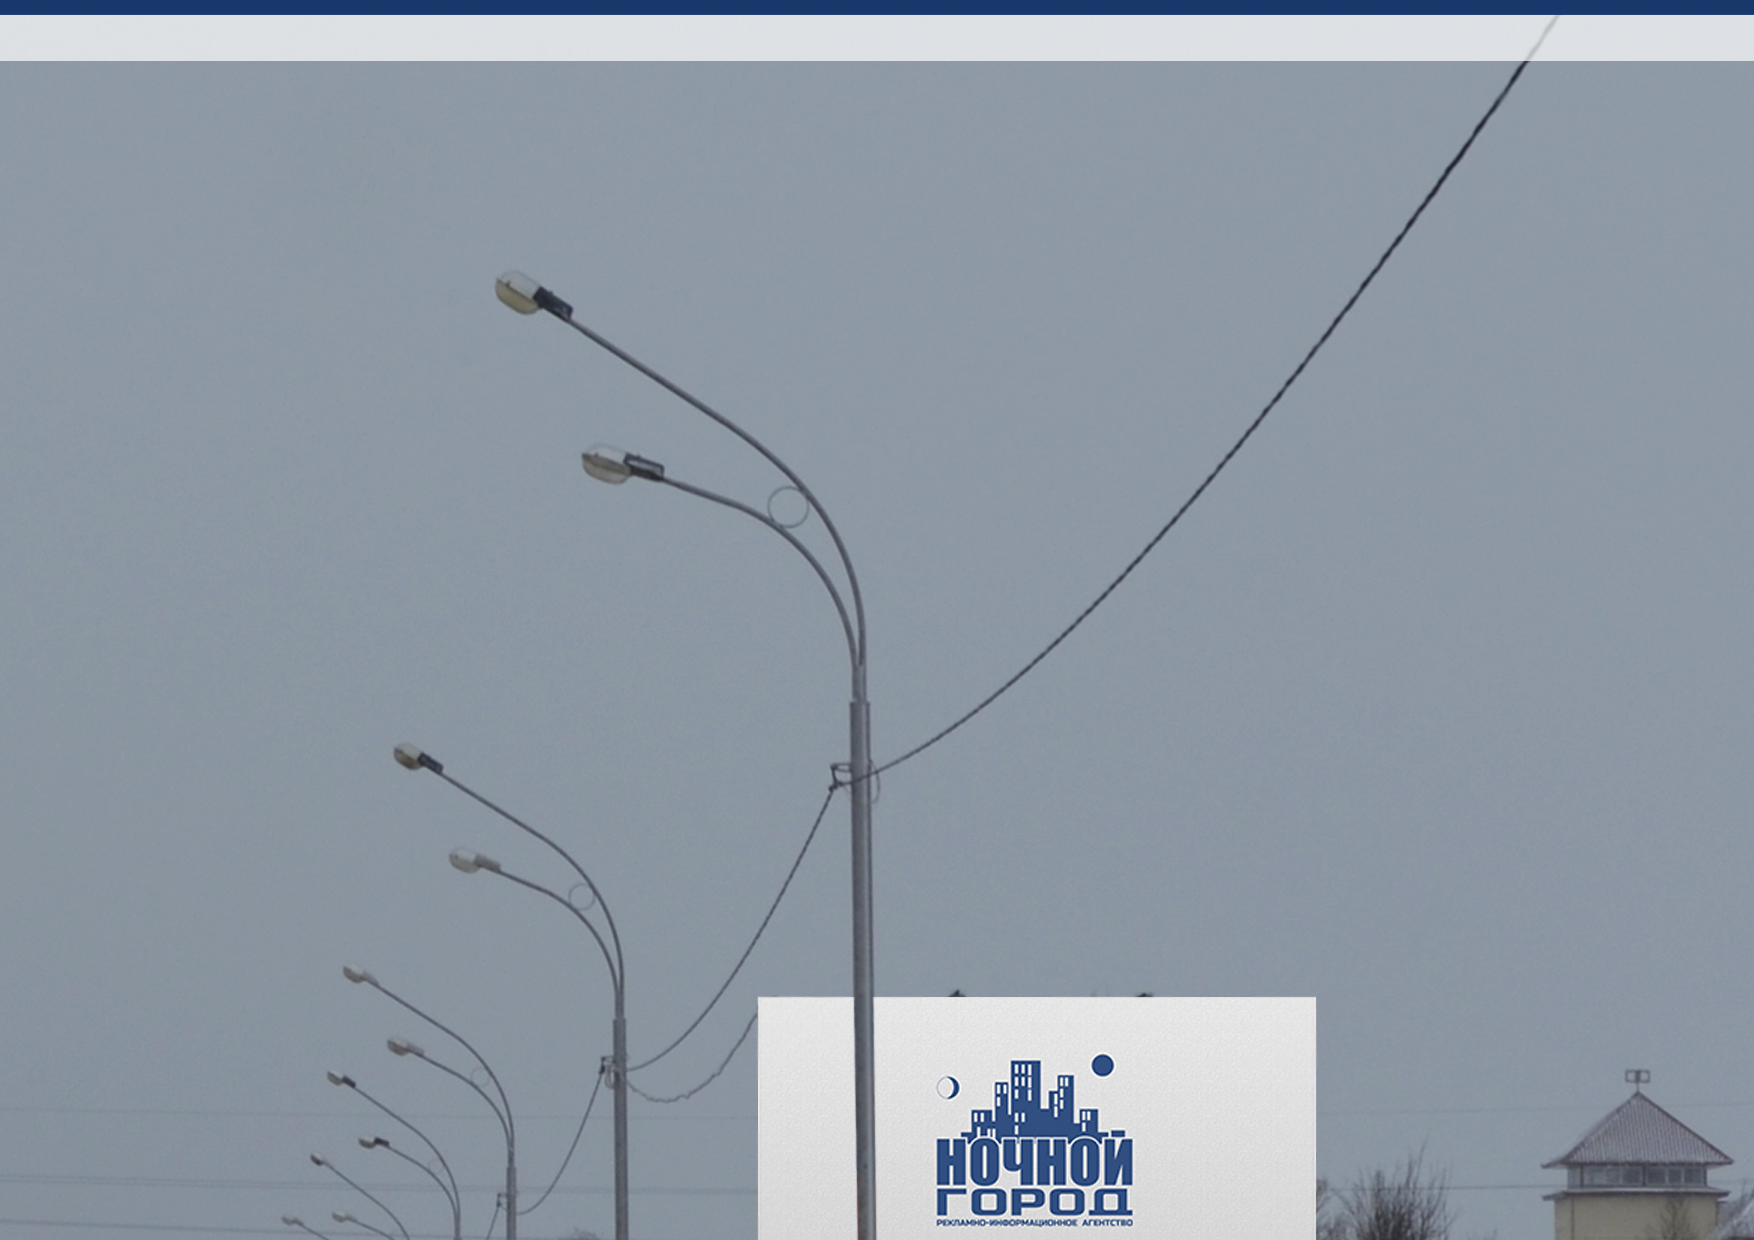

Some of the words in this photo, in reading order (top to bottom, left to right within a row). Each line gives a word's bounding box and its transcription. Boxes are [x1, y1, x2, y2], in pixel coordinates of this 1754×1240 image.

[937, 1130, 1133, 1187] НОЧНОЙ
[937, 1188, 1133, 1216] ГОРОД
[936, 1219, 1078, 1227] РЕКЛАМНО-ИНФОРМАЦИОННОЕ
[1082, 1219, 1133, 1227] АГЕНТСТВО
